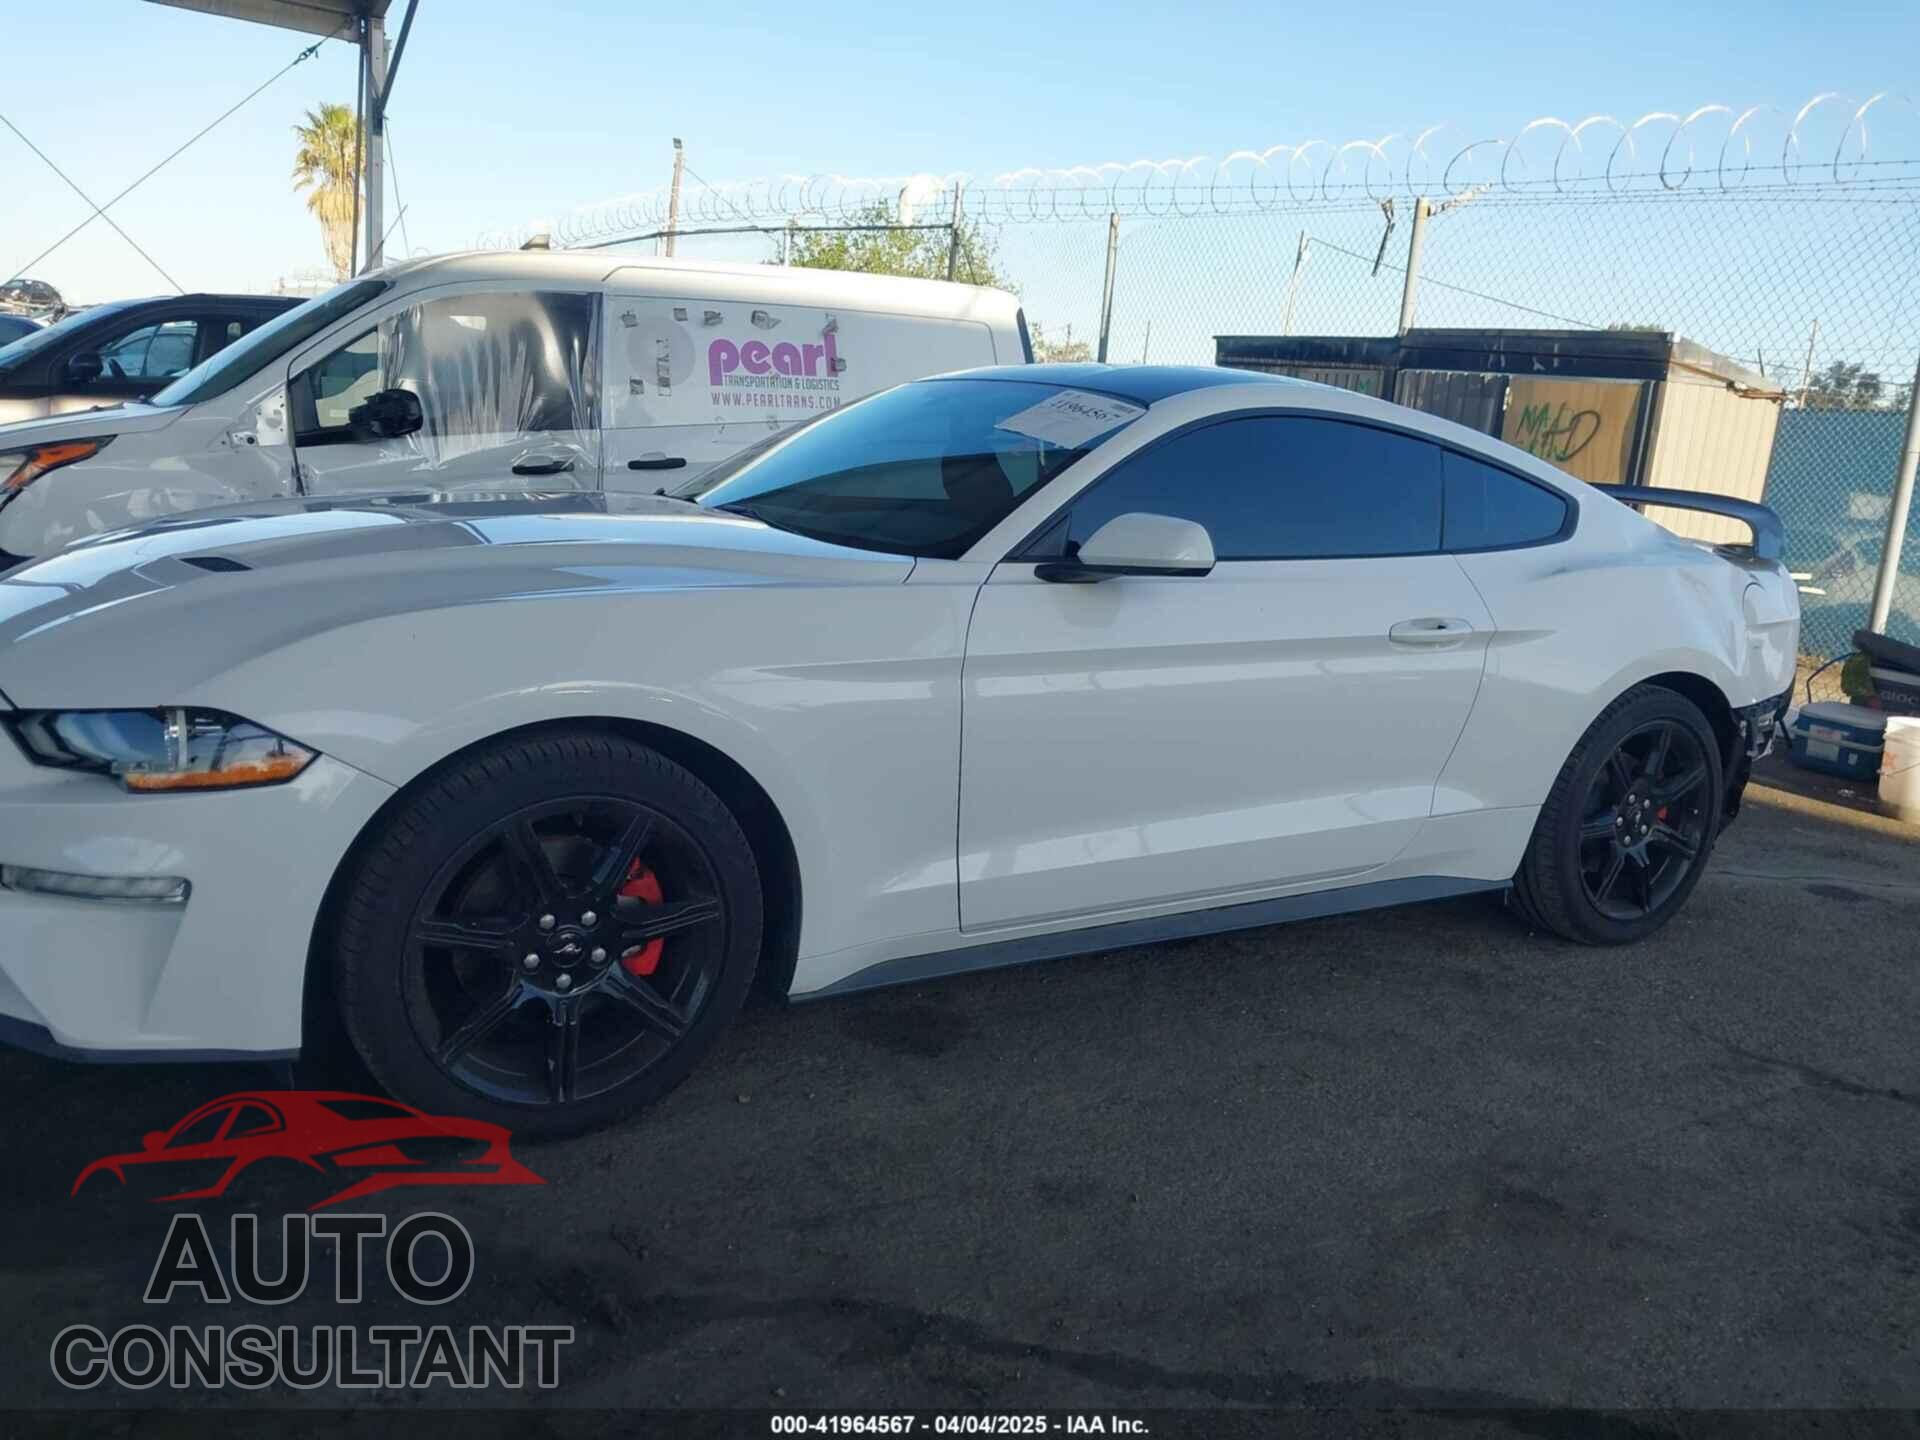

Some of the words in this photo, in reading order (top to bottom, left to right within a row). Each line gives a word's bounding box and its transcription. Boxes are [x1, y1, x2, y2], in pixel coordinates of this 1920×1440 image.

[708, 332, 839, 387] pearl
[723, 374, 793, 389] TRANSPORTATION
[802, 378, 840, 392] LOGISTICS
[711, 391, 841, 409] WWW.PEARLTRANS.COM
